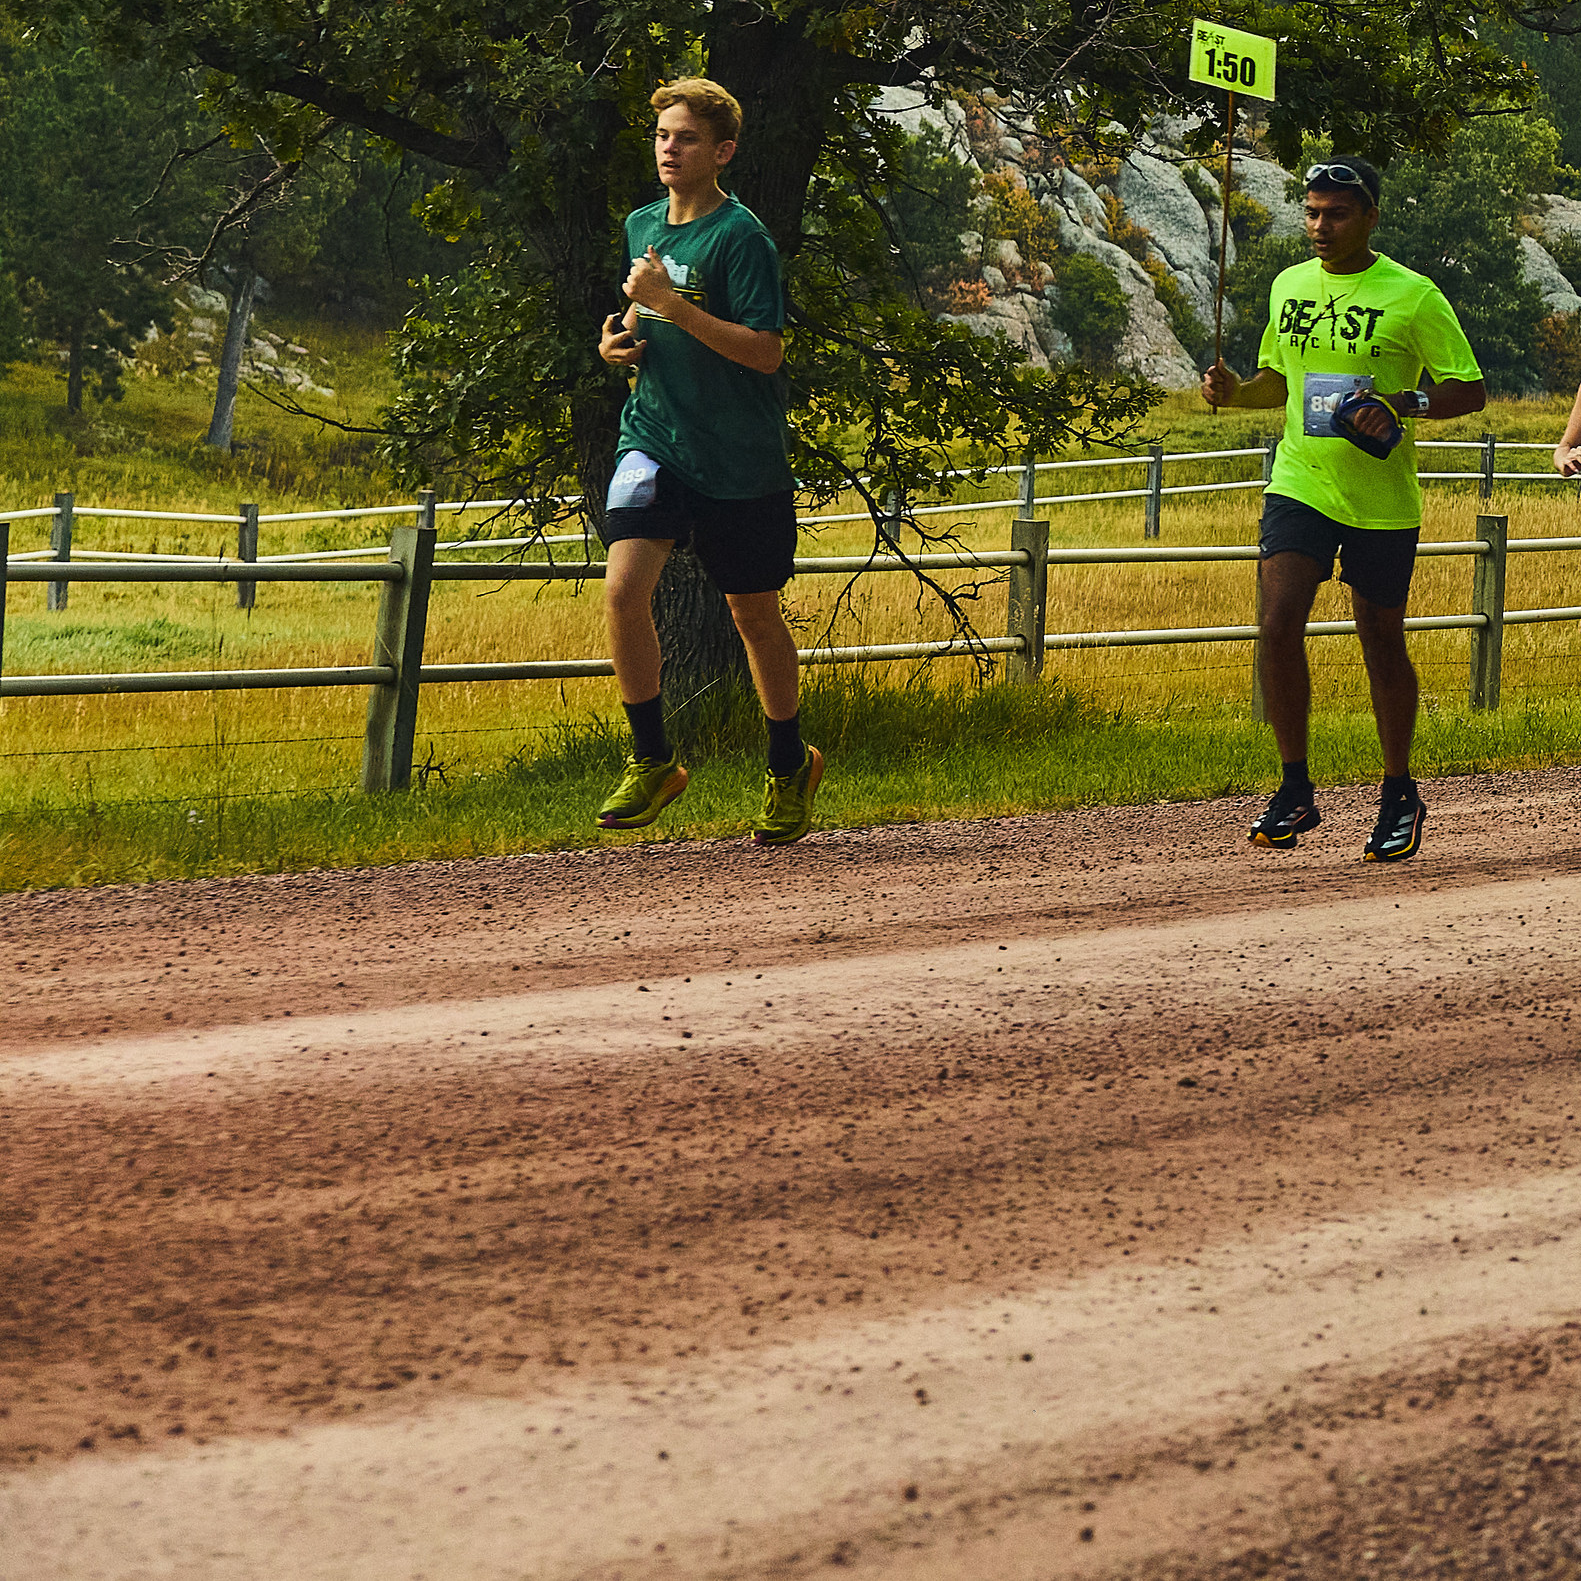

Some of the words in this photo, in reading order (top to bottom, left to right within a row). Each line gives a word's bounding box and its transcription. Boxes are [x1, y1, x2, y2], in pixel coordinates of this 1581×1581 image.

[1196, 29, 1226, 46] BEAST
[1205, 48, 1256, 87] 1:50
[1279, 294, 1385, 348] BEAST
